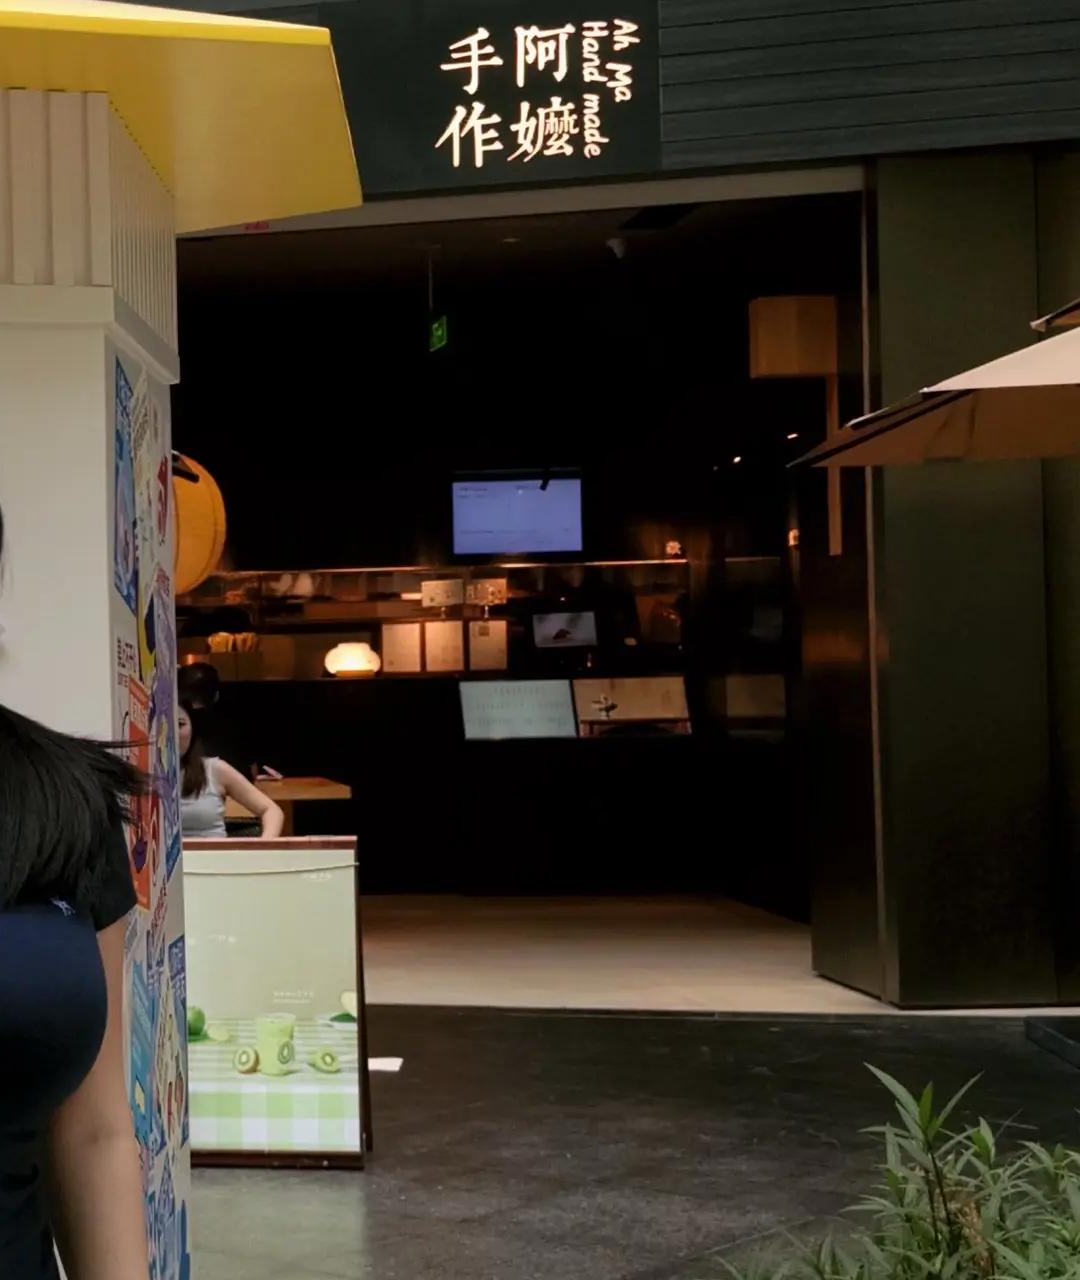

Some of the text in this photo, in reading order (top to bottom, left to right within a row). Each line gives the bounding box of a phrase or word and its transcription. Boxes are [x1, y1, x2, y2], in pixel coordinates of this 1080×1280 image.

[582, 21, 610, 158] Hand made
[605, 19, 641, 103] Ah Ma
